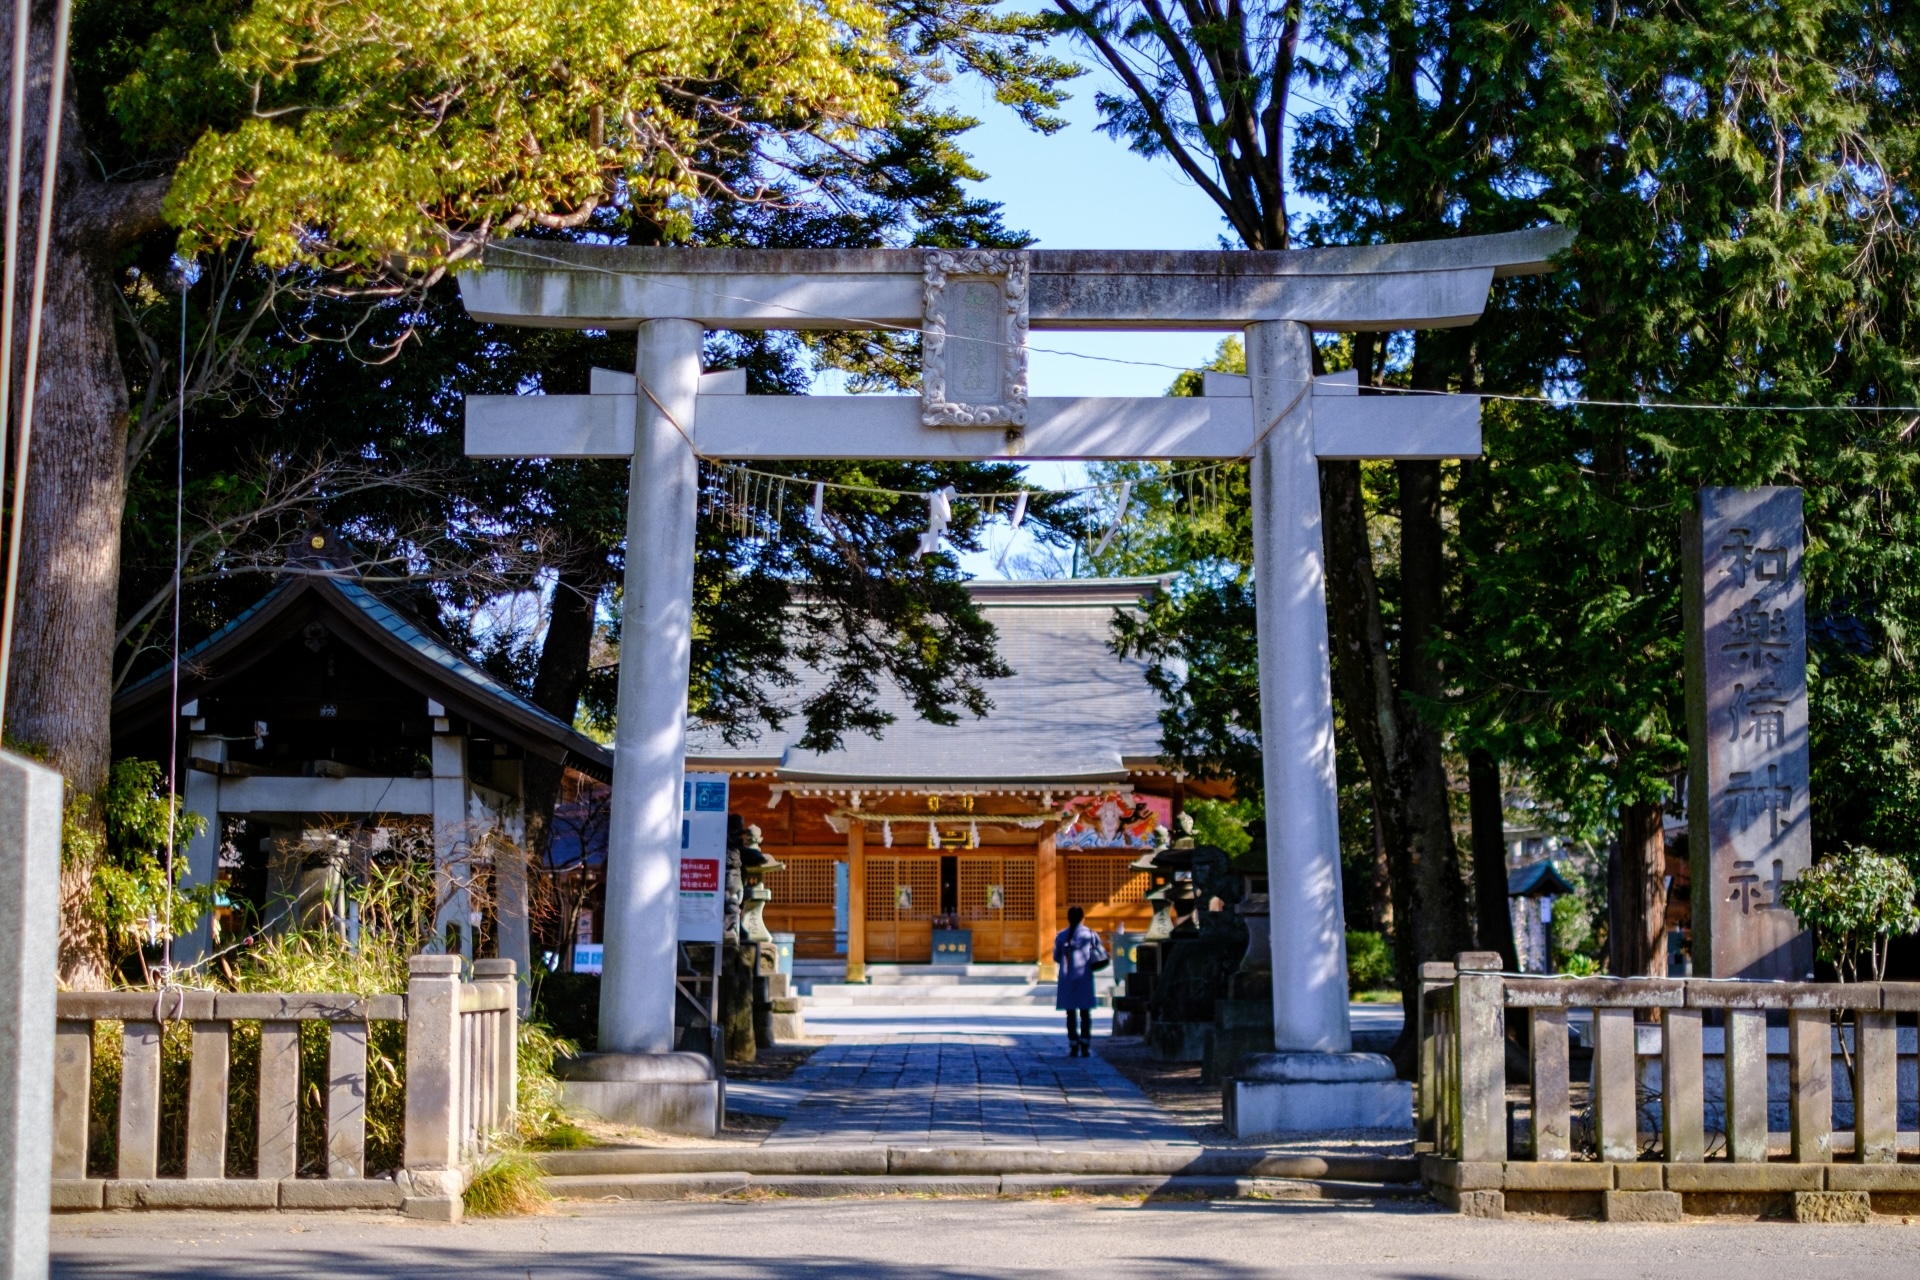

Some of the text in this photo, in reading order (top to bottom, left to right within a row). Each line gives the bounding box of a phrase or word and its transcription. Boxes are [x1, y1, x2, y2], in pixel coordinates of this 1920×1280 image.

[1721, 527, 1792, 916] 和樂備神社
